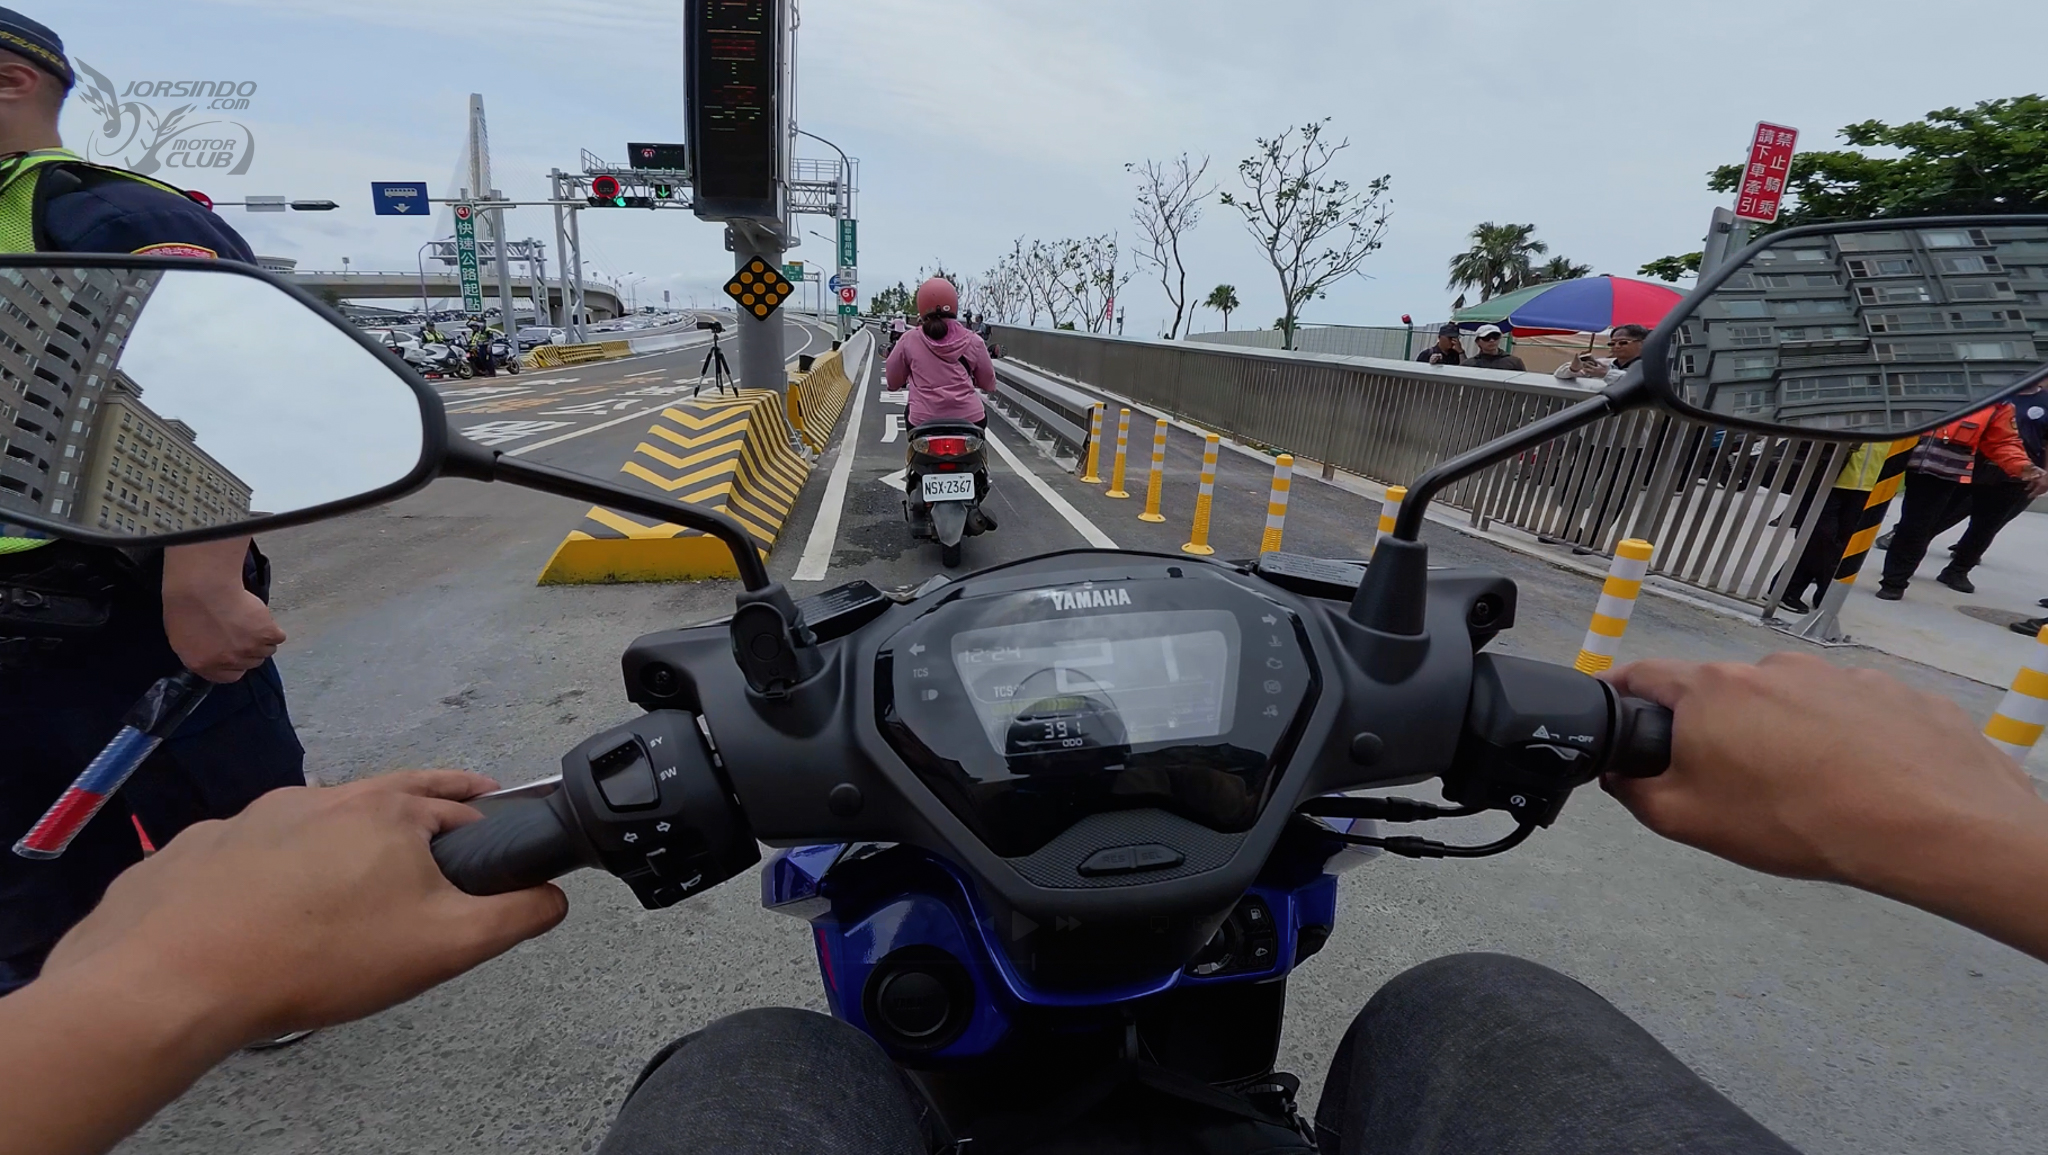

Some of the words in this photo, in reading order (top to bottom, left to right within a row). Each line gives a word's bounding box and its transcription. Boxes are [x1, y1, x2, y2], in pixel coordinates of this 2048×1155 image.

[1740, 127, 1776, 214] 請下車牽引
[1758, 132, 1794, 216] 禁止騎乘
[457, 206, 470, 215] 61
[457, 221, 481, 312] 快速公路起點
[841, 290, 855, 298] 61
[1050, 588, 1132, 611] YAMAHA
[913, 667, 929, 678] TCS
[993, 685, 1014, 698] TCS
[1044, 720, 1082, 739] 391
